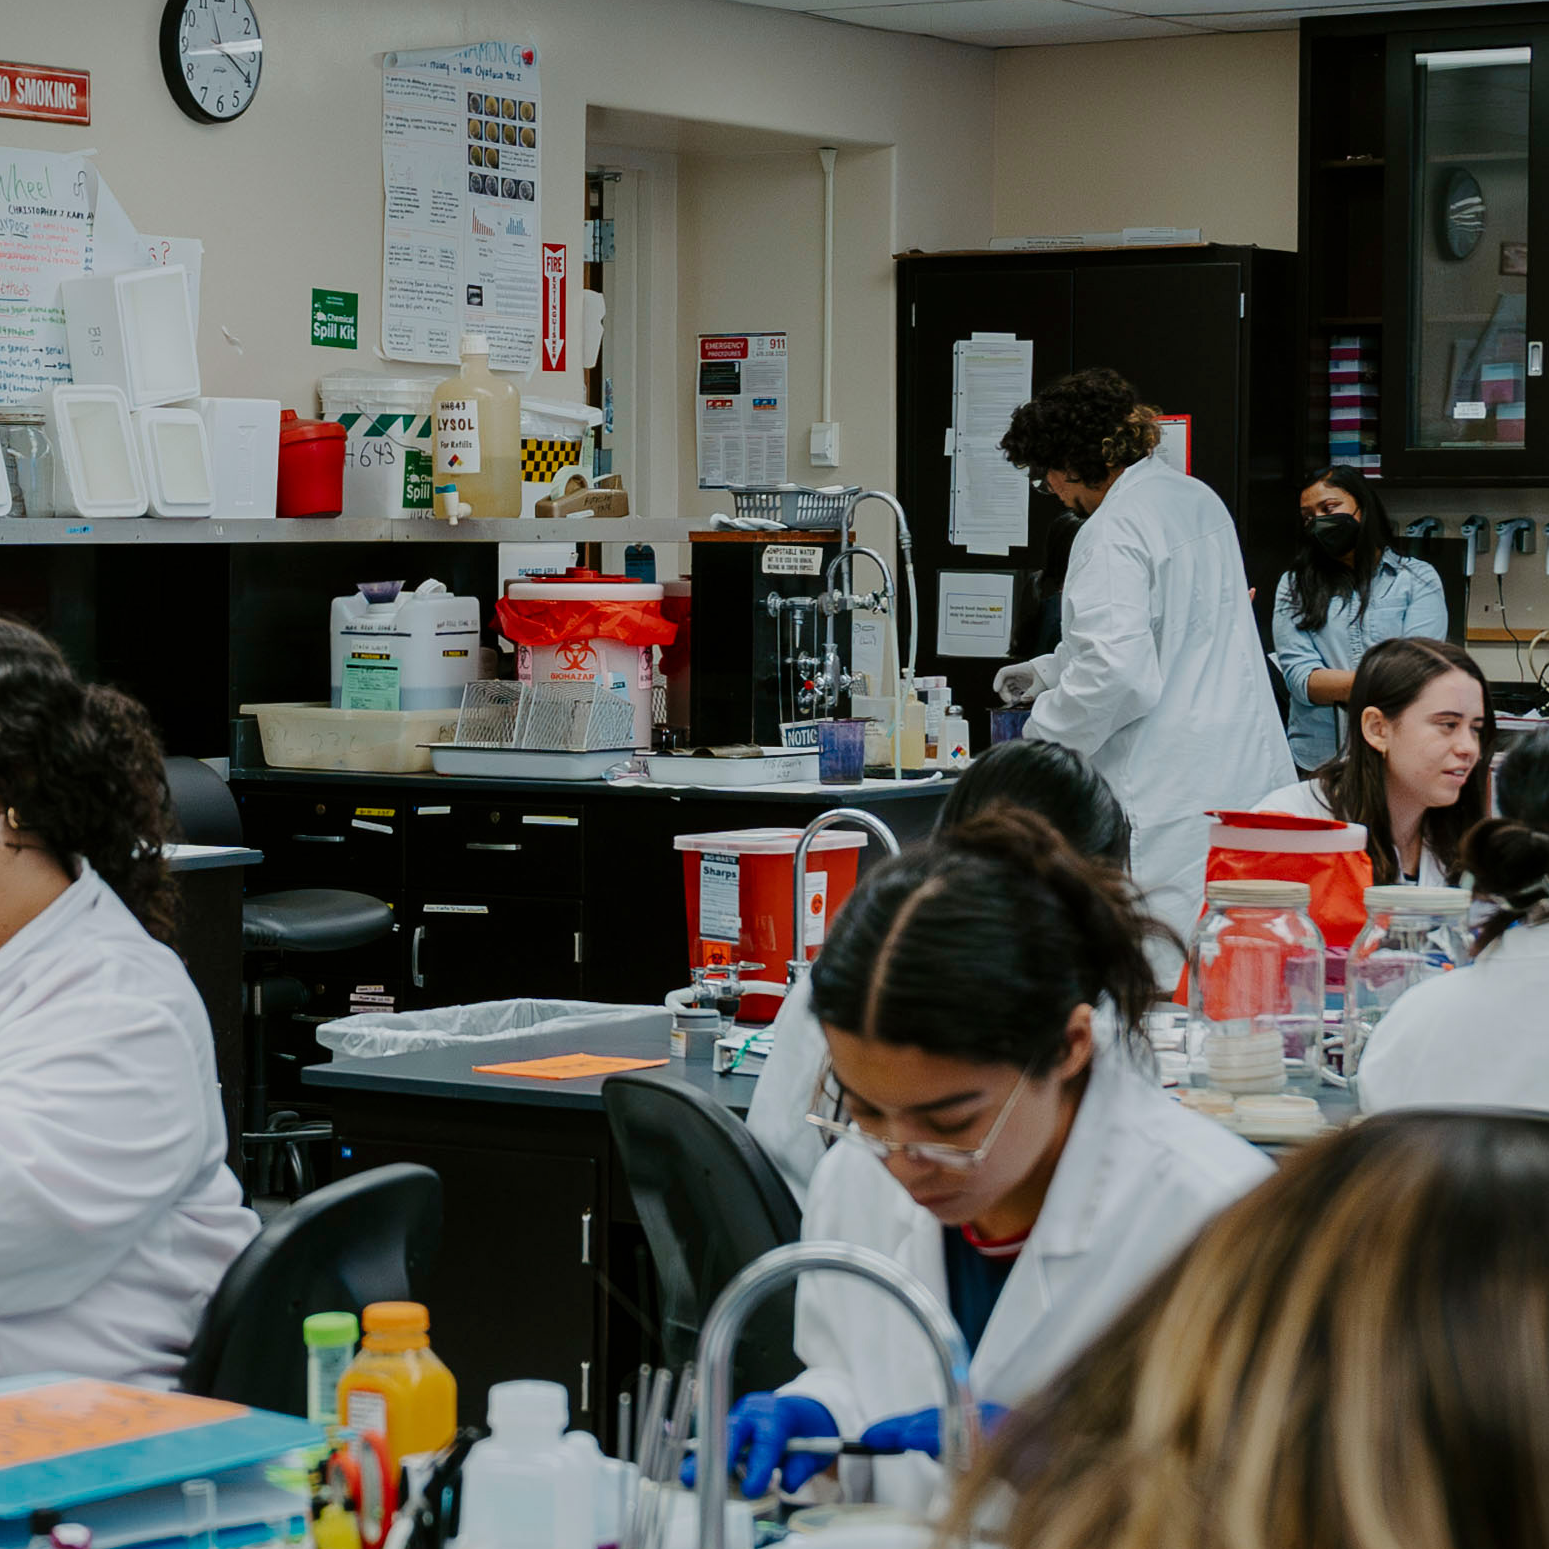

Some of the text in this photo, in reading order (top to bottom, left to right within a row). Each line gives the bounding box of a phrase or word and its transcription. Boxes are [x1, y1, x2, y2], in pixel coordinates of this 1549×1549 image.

[183, 9, 196, 27] 10
[243, 17, 251, 35] 2
[181, 36, 189, 54] 9
[186, 62, 195, 81] 8
[15, 76, 77, 110] SMOKING
[200, 86, 208, 104] 7
[232, 90, 240, 108] 5
[216, 94, 224, 113] 6
[546, 256, 563, 273] FIRE
[327, 313, 355, 324] Chemical
[312, 321, 356, 341] Spill Kit
[769, 338, 786, 350] 911
[437, 418, 475, 431] LYSOL
[440, 440, 473, 449] For Refills
[405, 484, 430, 502] Spill
[550, 672, 595, 681] BIOHAZAR
[787, 728, 818, 747] NOTIC
[702, 866, 737, 880] Sharps
